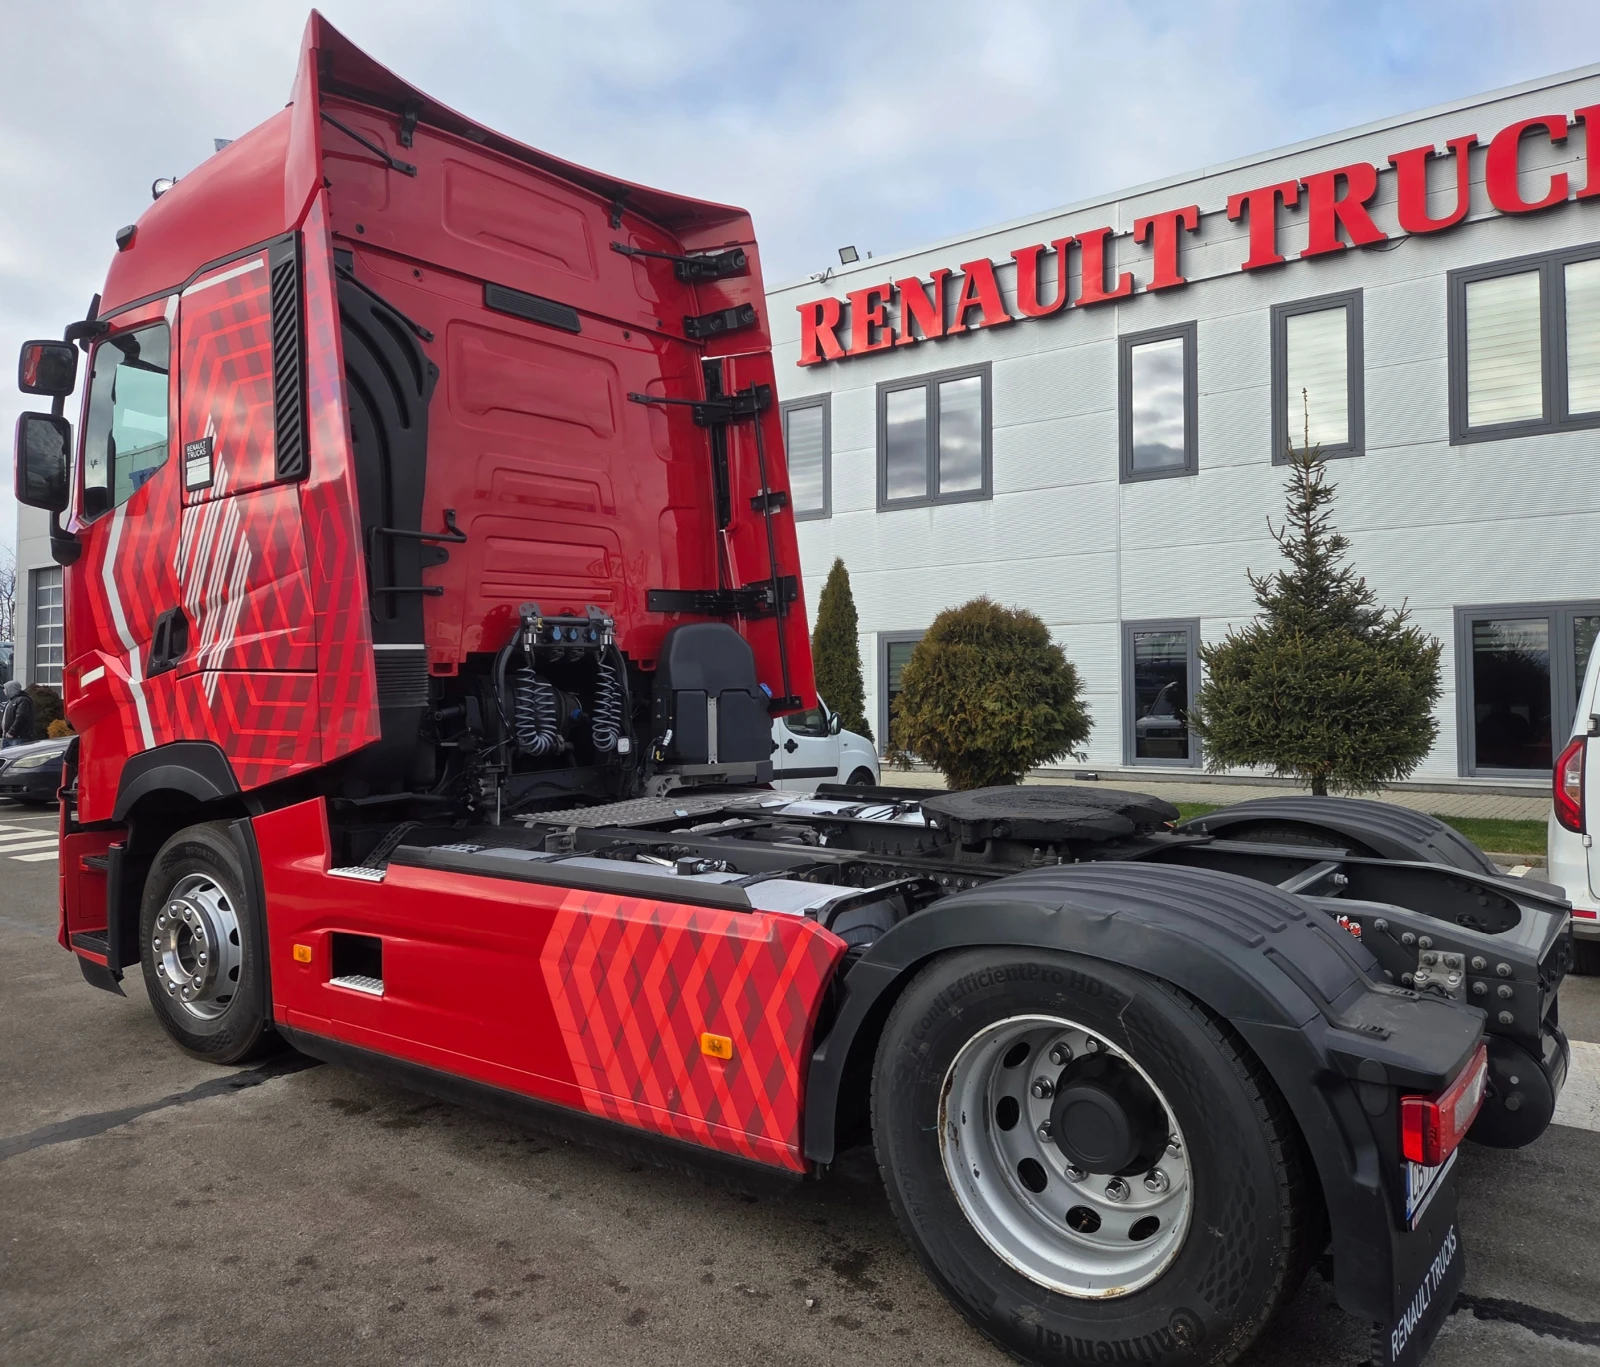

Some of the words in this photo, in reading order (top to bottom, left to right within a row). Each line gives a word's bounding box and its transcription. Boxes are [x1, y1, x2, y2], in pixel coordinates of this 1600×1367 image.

[796, 204, 1200, 367] RENAULT
[187, 441, 206, 453] RENAULT
[187, 448, 206, 459] TRUCKS
[1391, 1272, 1431, 1362] RENAULT
[1430, 1224, 1457, 1291] TRUCKS
